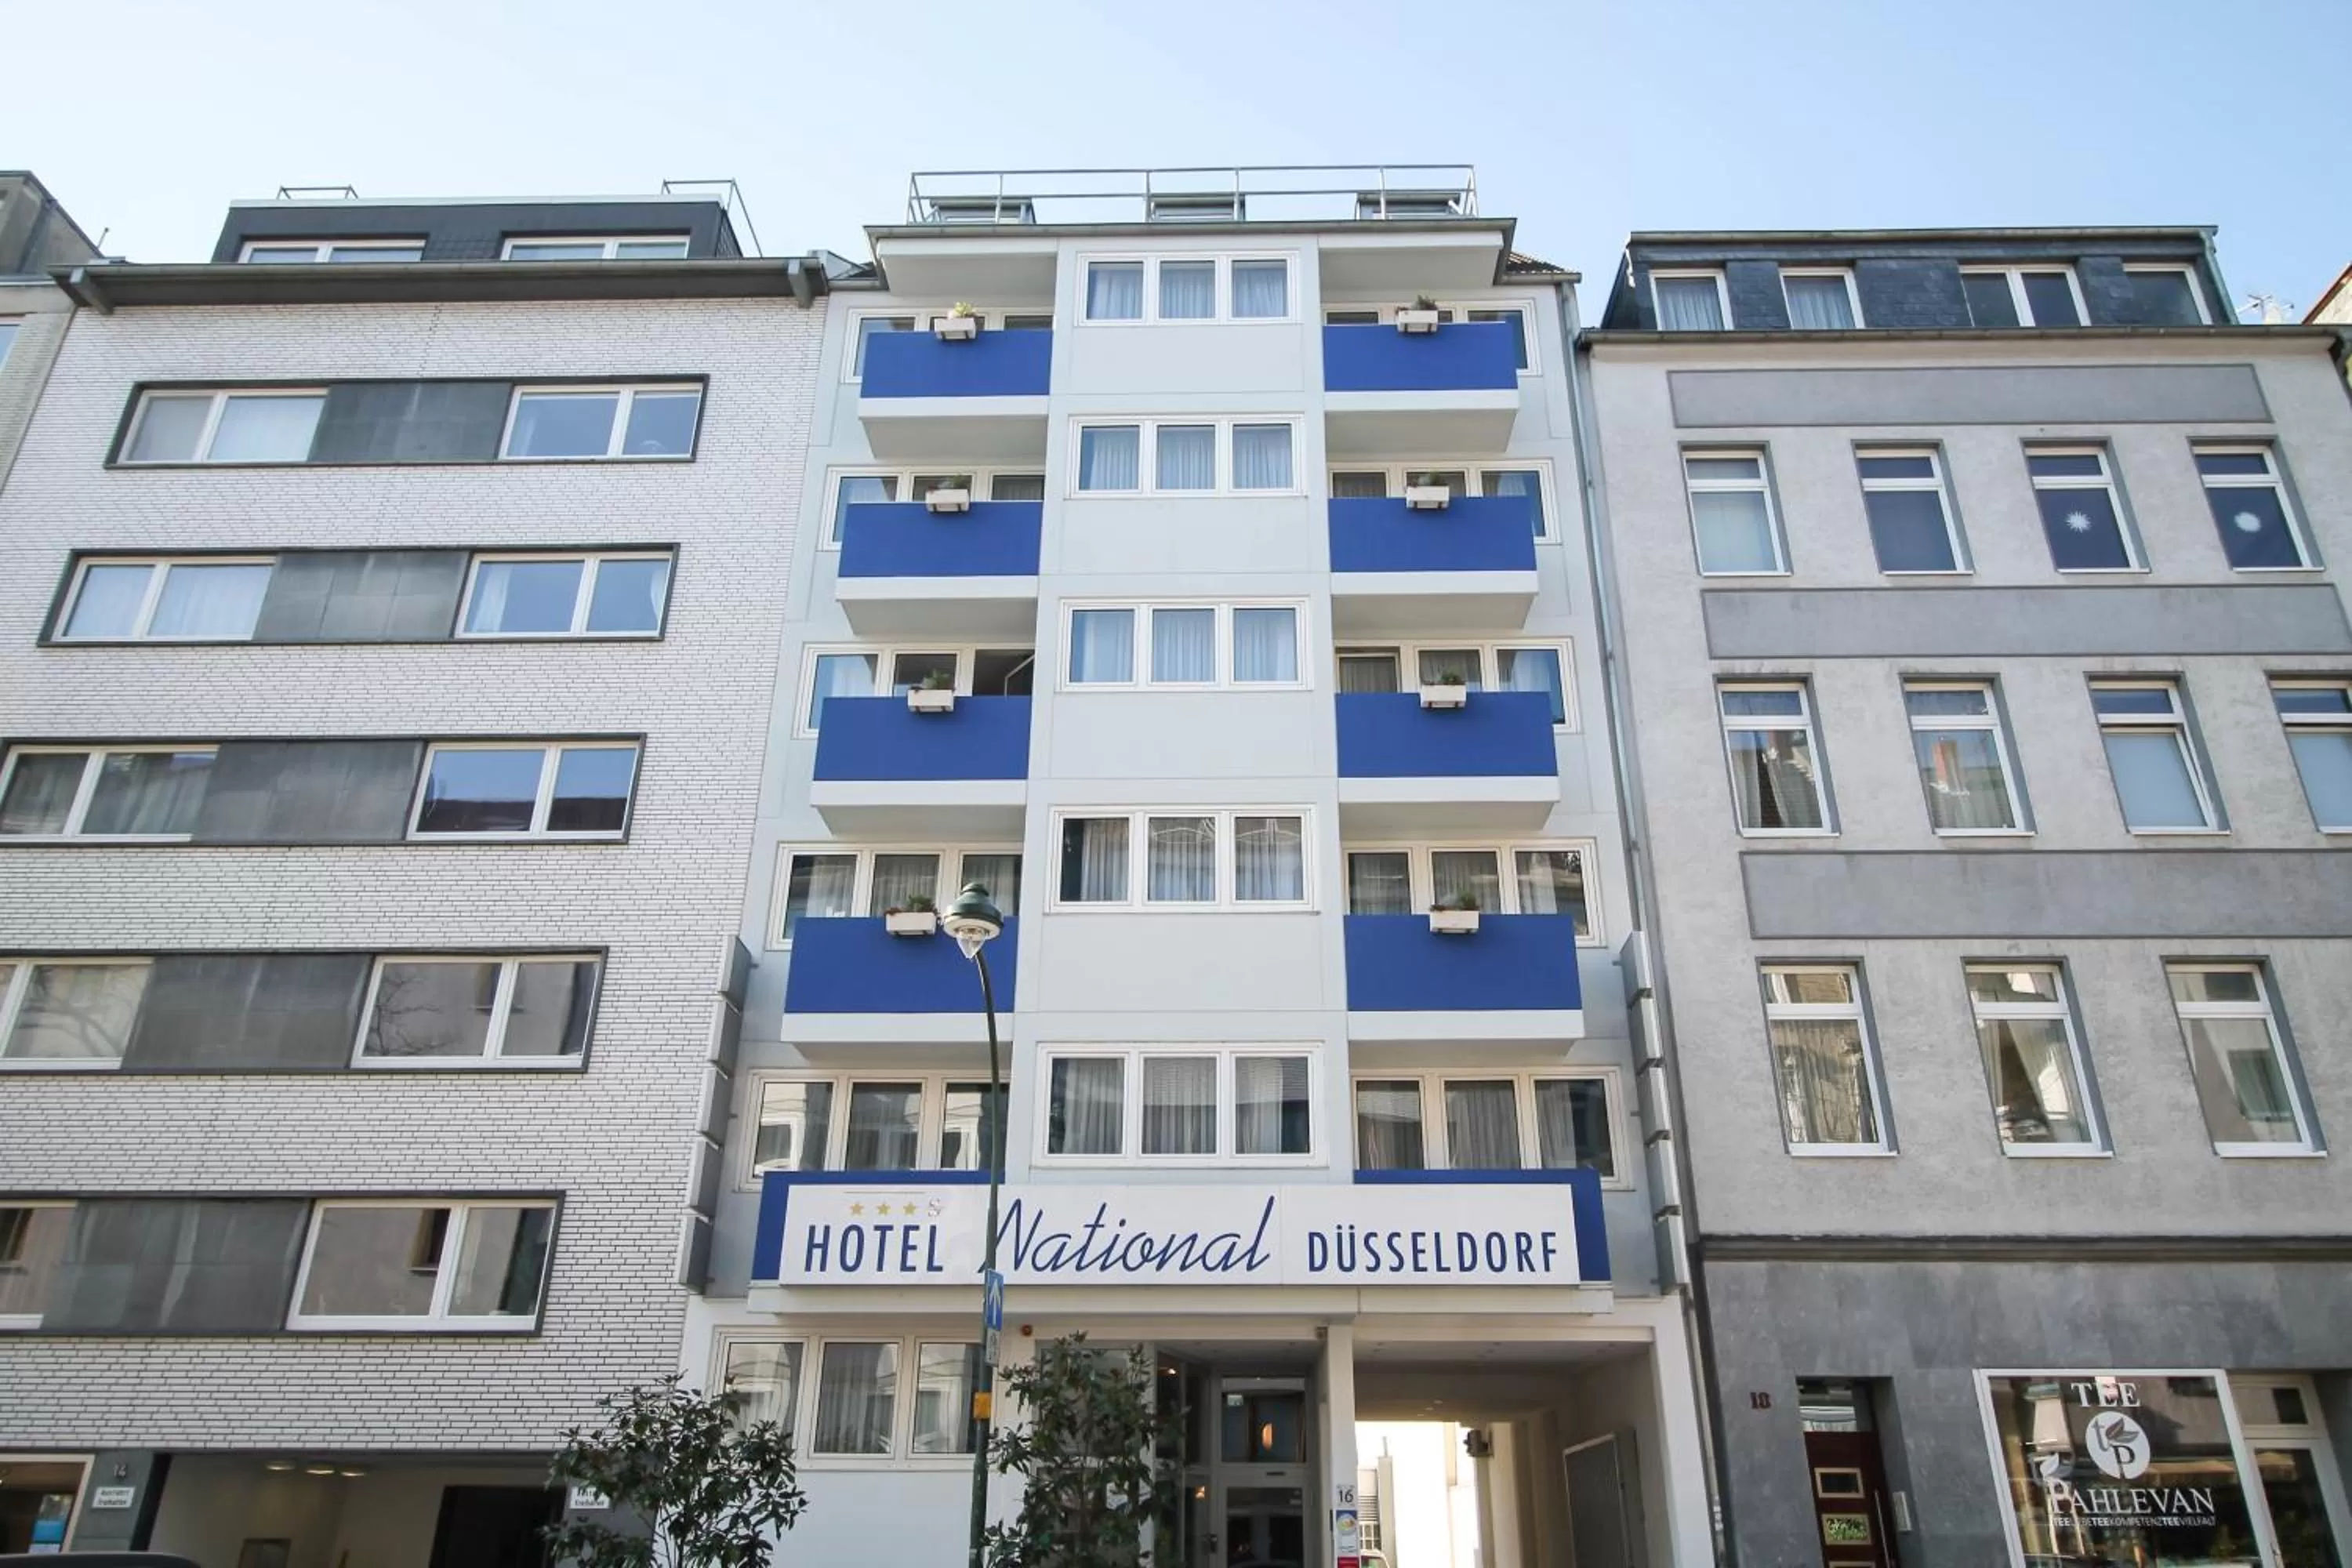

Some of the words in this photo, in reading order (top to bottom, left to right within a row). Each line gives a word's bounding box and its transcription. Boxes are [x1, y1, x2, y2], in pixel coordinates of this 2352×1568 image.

[804, 1224, 944, 1272] HOTEL
[978, 1195, 1276, 1272] National
[1308, 1224, 1558, 1273] DÜSSELDORF
[2071, 1382, 2141, 1407] TEE
[1338, 1489, 1354, 1503] 16
[2048, 1477, 2216, 1515] PAHLEVAN
